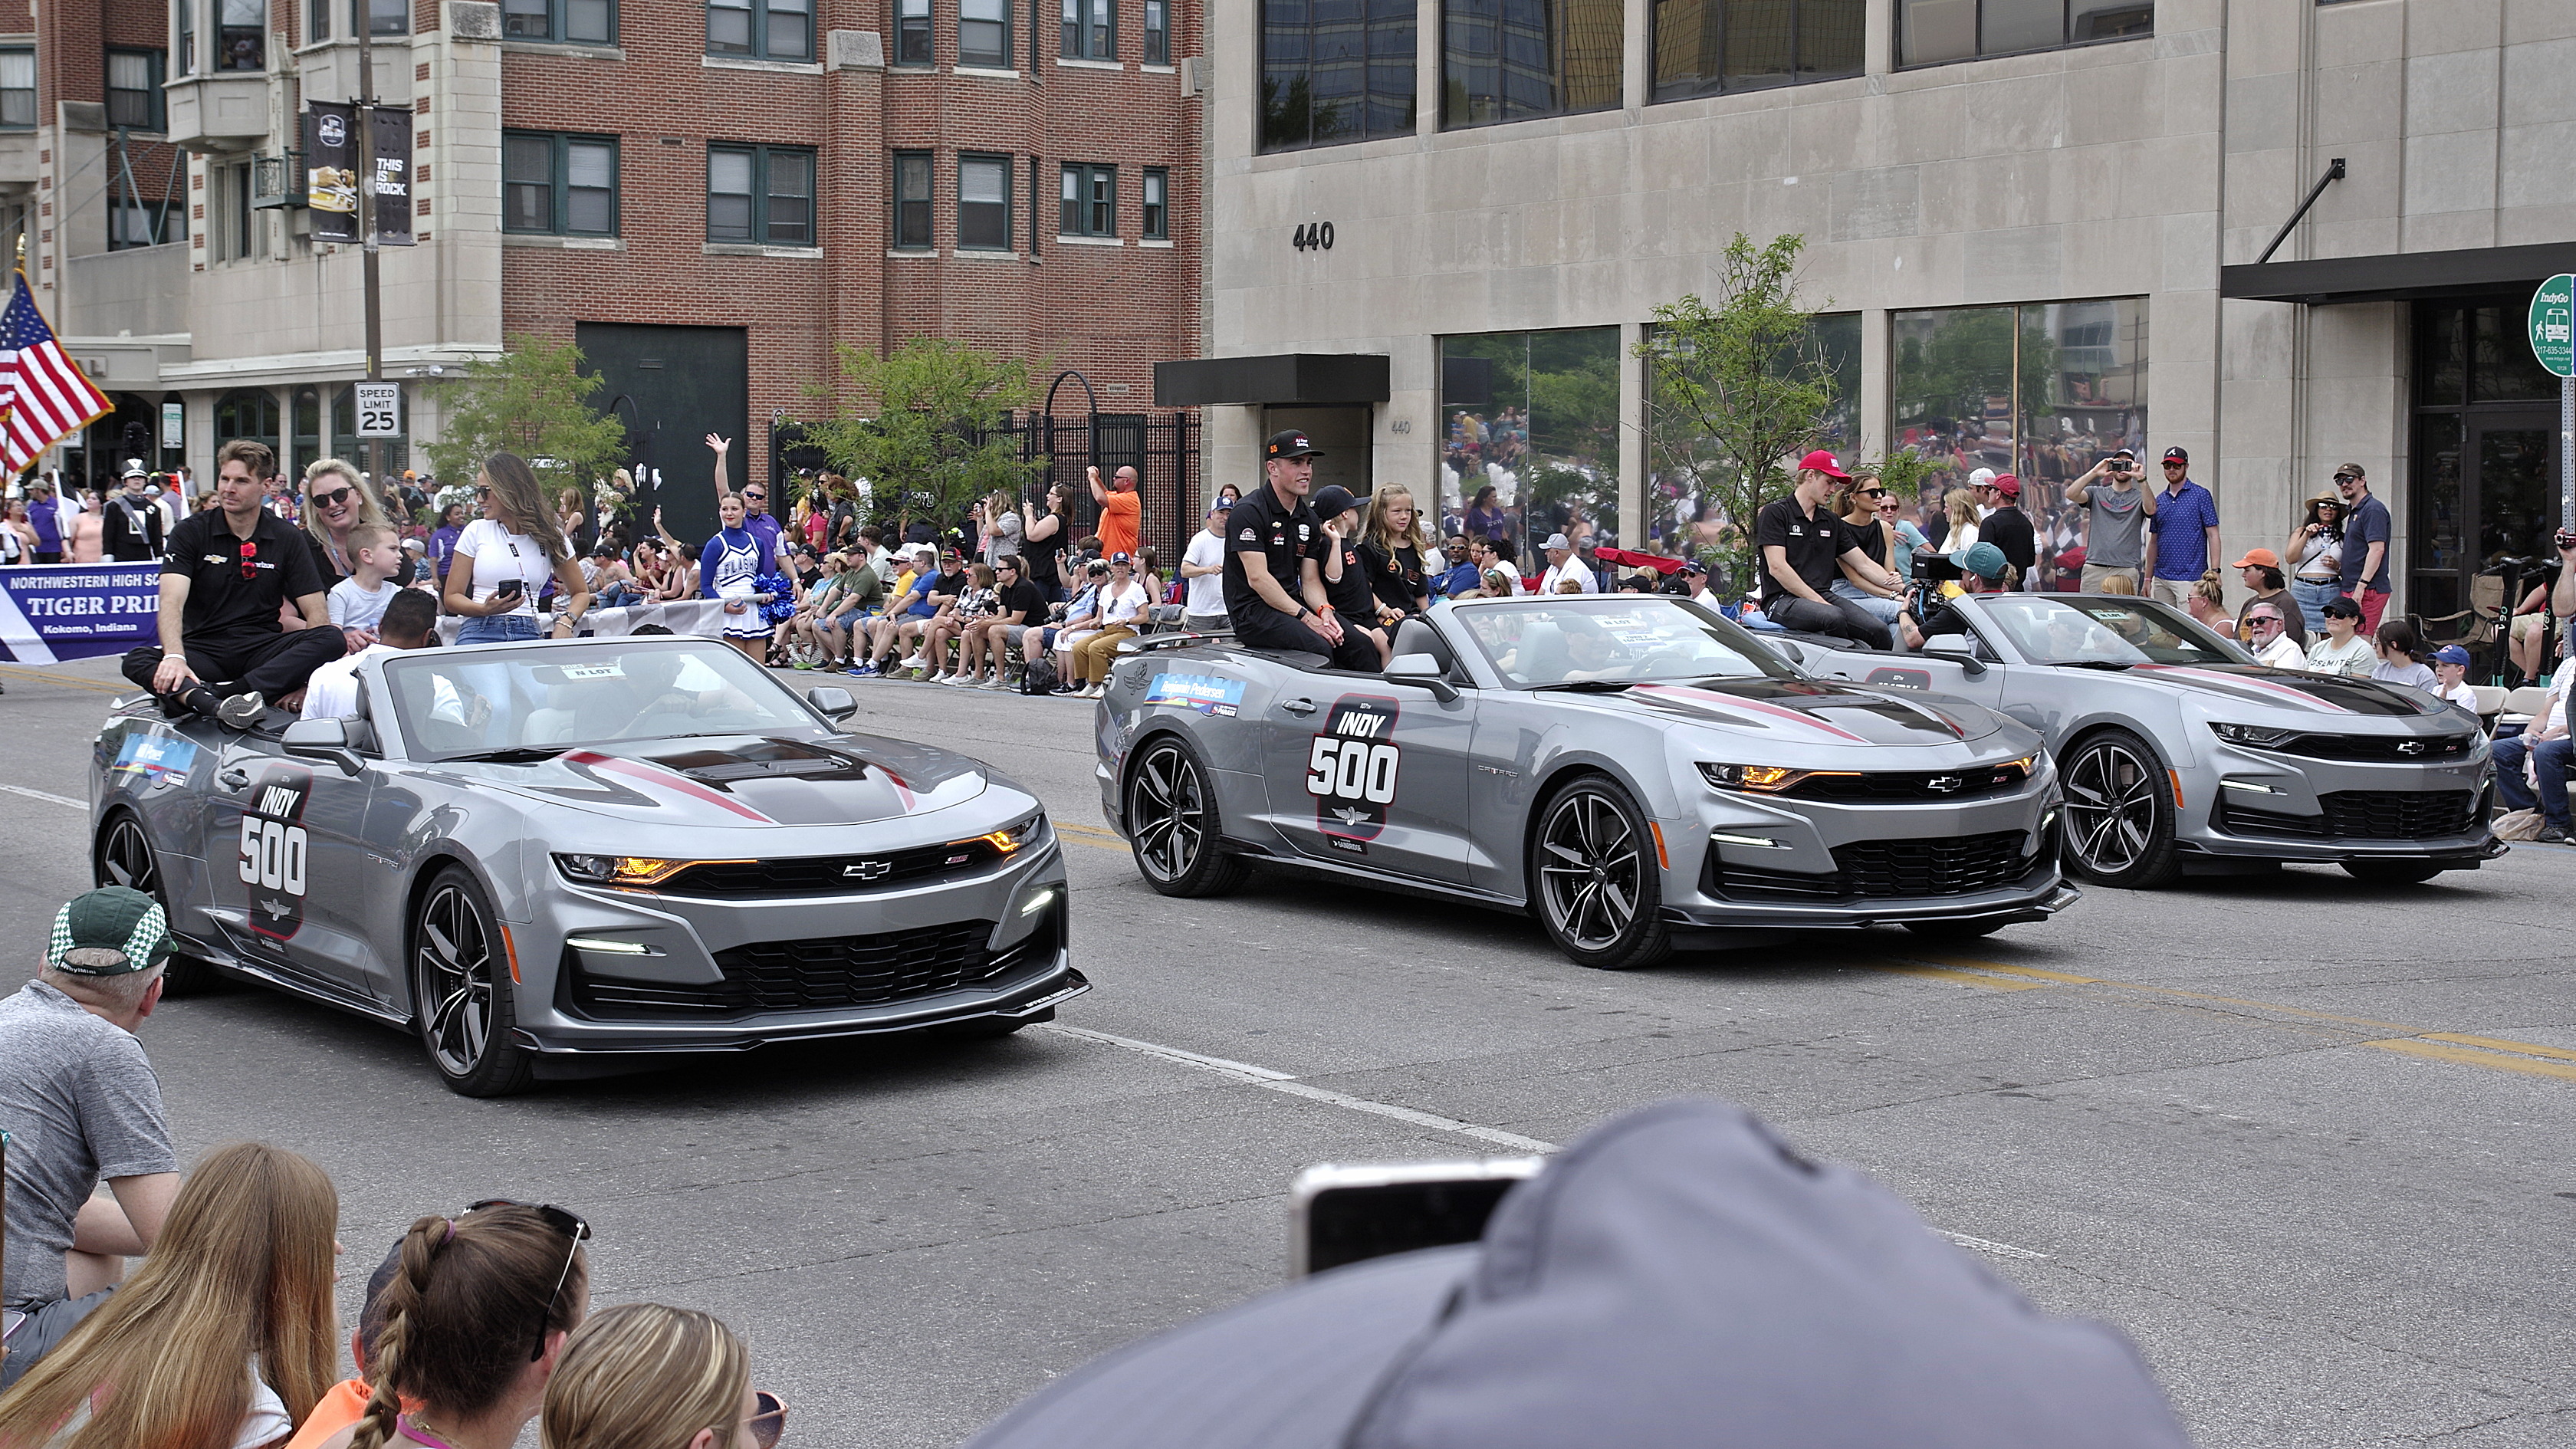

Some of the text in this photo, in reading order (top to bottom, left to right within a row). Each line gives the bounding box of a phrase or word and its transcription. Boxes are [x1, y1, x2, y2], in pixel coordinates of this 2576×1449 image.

[376, 157, 403, 172] THIS
[376, 170, 388, 182] IS
[376, 181, 407, 196] ROCK.
[1293, 221, 1335, 251] 440
[2540, 292, 2569, 304] IndyGo
[2536, 346, 2571, 355] 317-635-3344
[360, 389, 395, 398] SPEED
[363, 400, 391, 409] LIMIT
[361, 411, 395, 431] 25
[1391, 420, 1411, 435] 440
[1270, 444, 1278, 454] 55
[1344, 550, 1356, 566] 55
[10, 575, 110, 590] NORTHWESTERN
[111, 574, 143, 587] HIGH
[27, 596, 105, 616] TIGER
[43, 623, 137, 635] Kokomo, Indiana
[1161, 680, 1226, 699] Benjamin Pedersen
[1336, 711, 1387, 738] INDY
[1307, 736, 1399, 804] 500
[259, 785, 301, 818] INDY
[239, 815, 307, 896] 500
